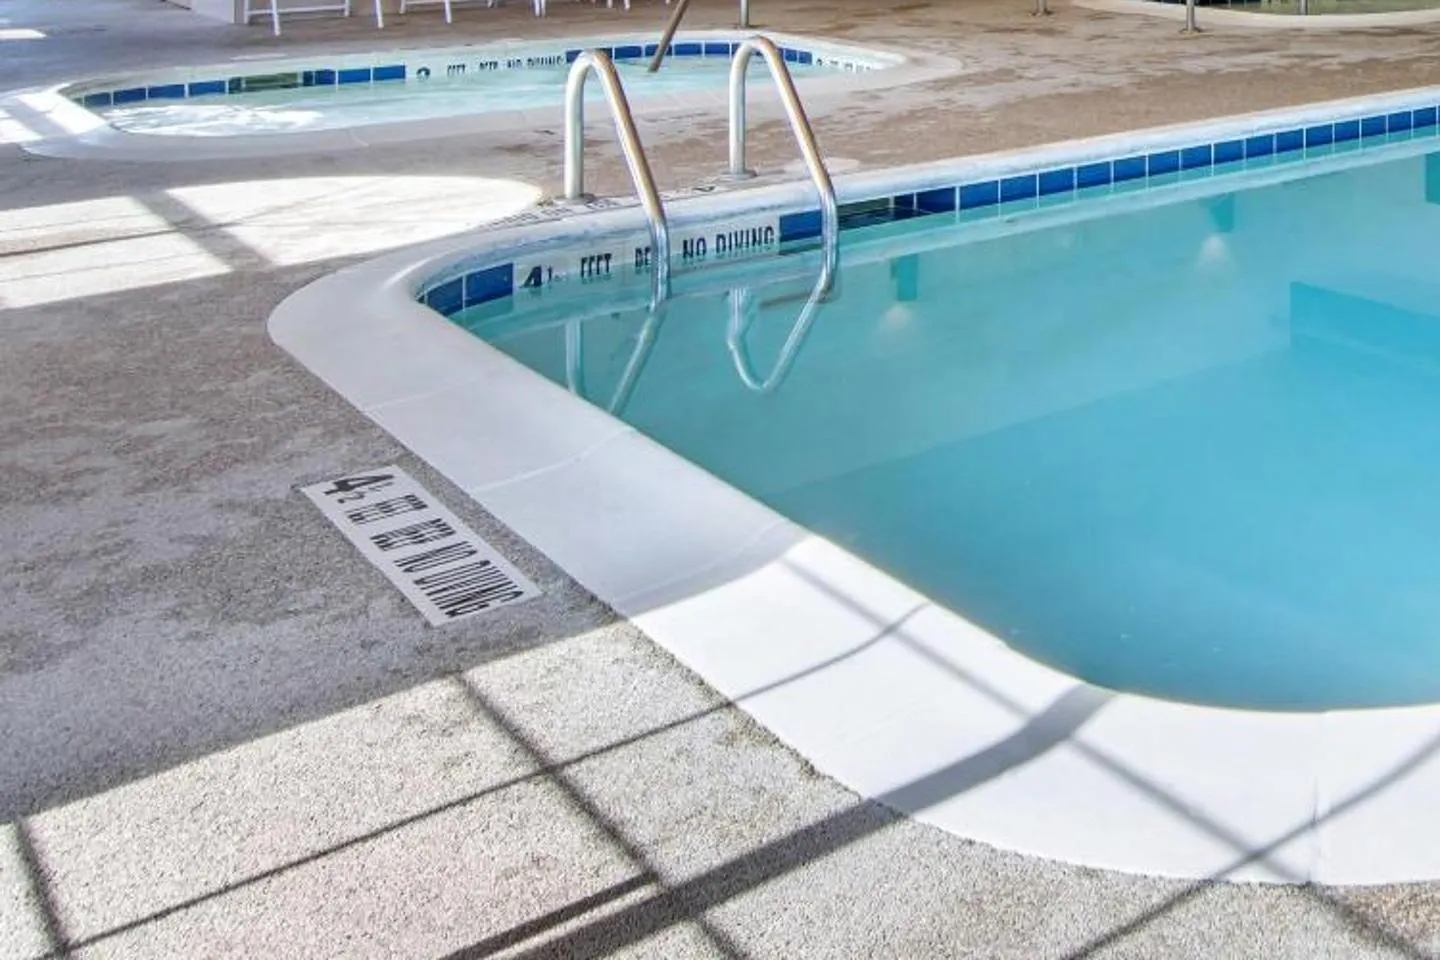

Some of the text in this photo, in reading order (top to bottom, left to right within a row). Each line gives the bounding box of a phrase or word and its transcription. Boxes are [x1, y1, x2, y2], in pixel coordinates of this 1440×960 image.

[682, 237, 708, 259] NO
[715, 225, 775, 255] DIVING
[343, 493, 429, 526] FEET
[369, 517, 457, 552] DEEP
[393, 540, 478, 573] NO
[413, 559, 525, 618] DIVING
